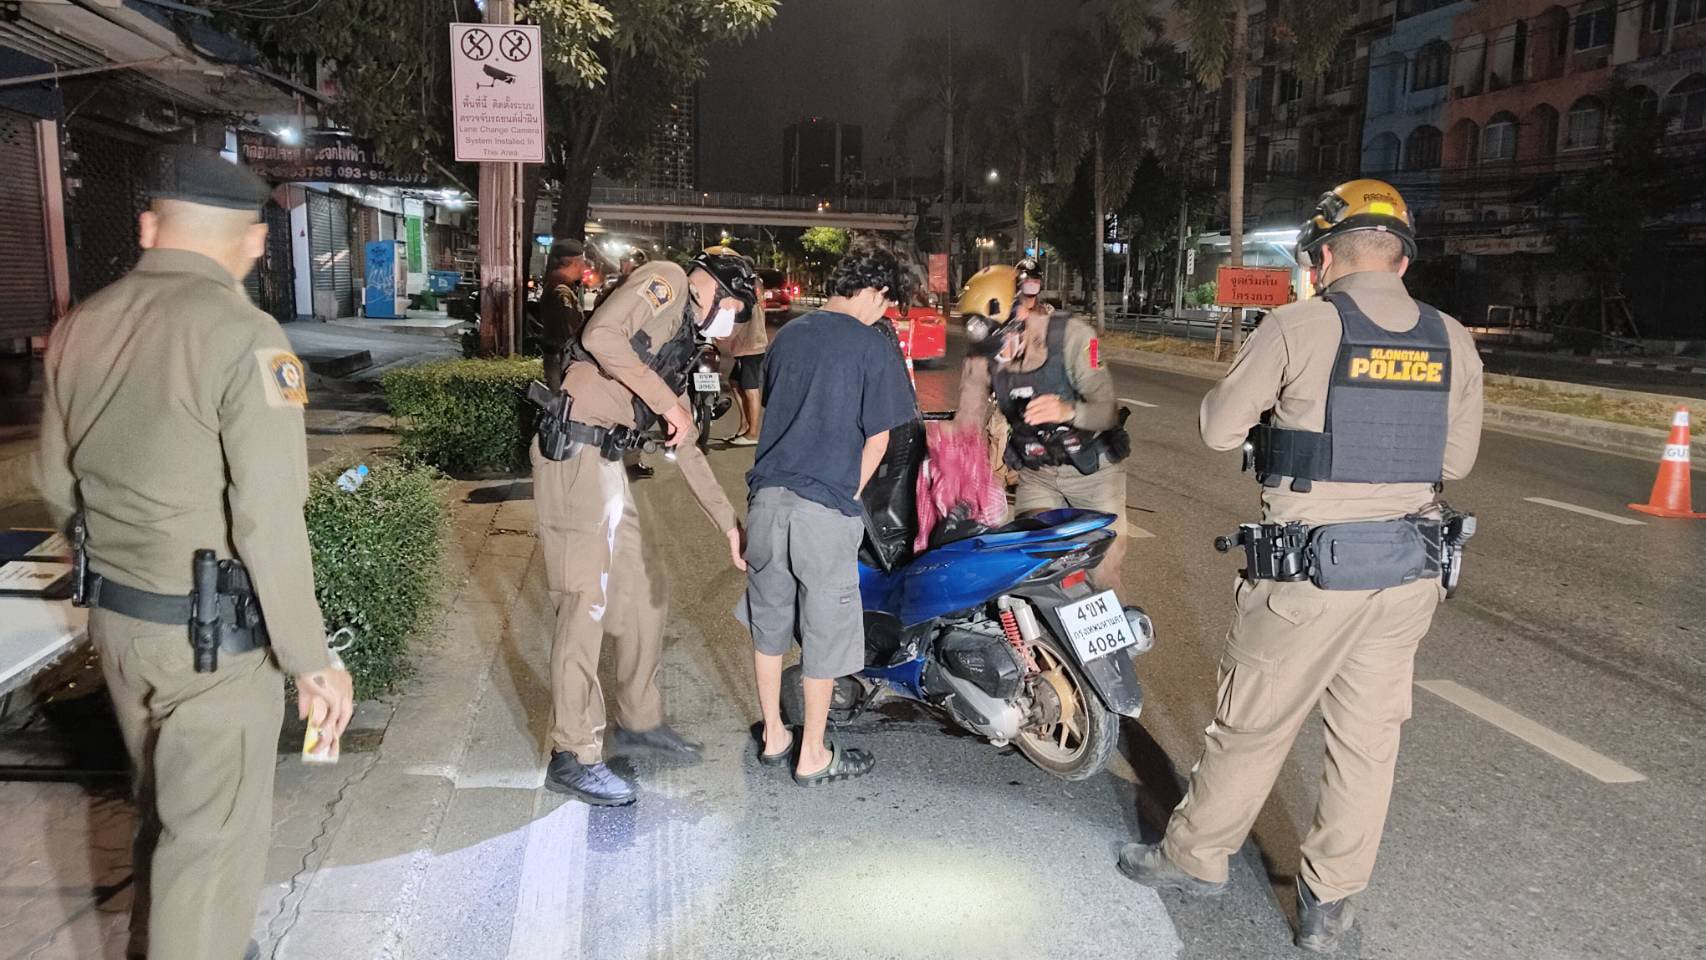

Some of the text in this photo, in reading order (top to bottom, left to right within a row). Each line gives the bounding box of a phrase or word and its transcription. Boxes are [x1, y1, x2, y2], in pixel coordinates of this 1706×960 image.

[462, 95, 535, 110] พื้นที่นี้ ติดตั้งระบบ
[459, 125, 540, 135] Lane Change Camera
[465, 137, 493, 146] System
[495, 137, 525, 145] Installed
[483, 148, 498, 156] This
[1231, 288, 1274, 302] โครงการ
[1370, 347, 1429, 362] KLONGTAN
[1349, 357, 1443, 383] POLICE
[1073, 614, 1124, 640] กรุงเทพมหานคร
[1088, 629, 1126, 655] 4084
